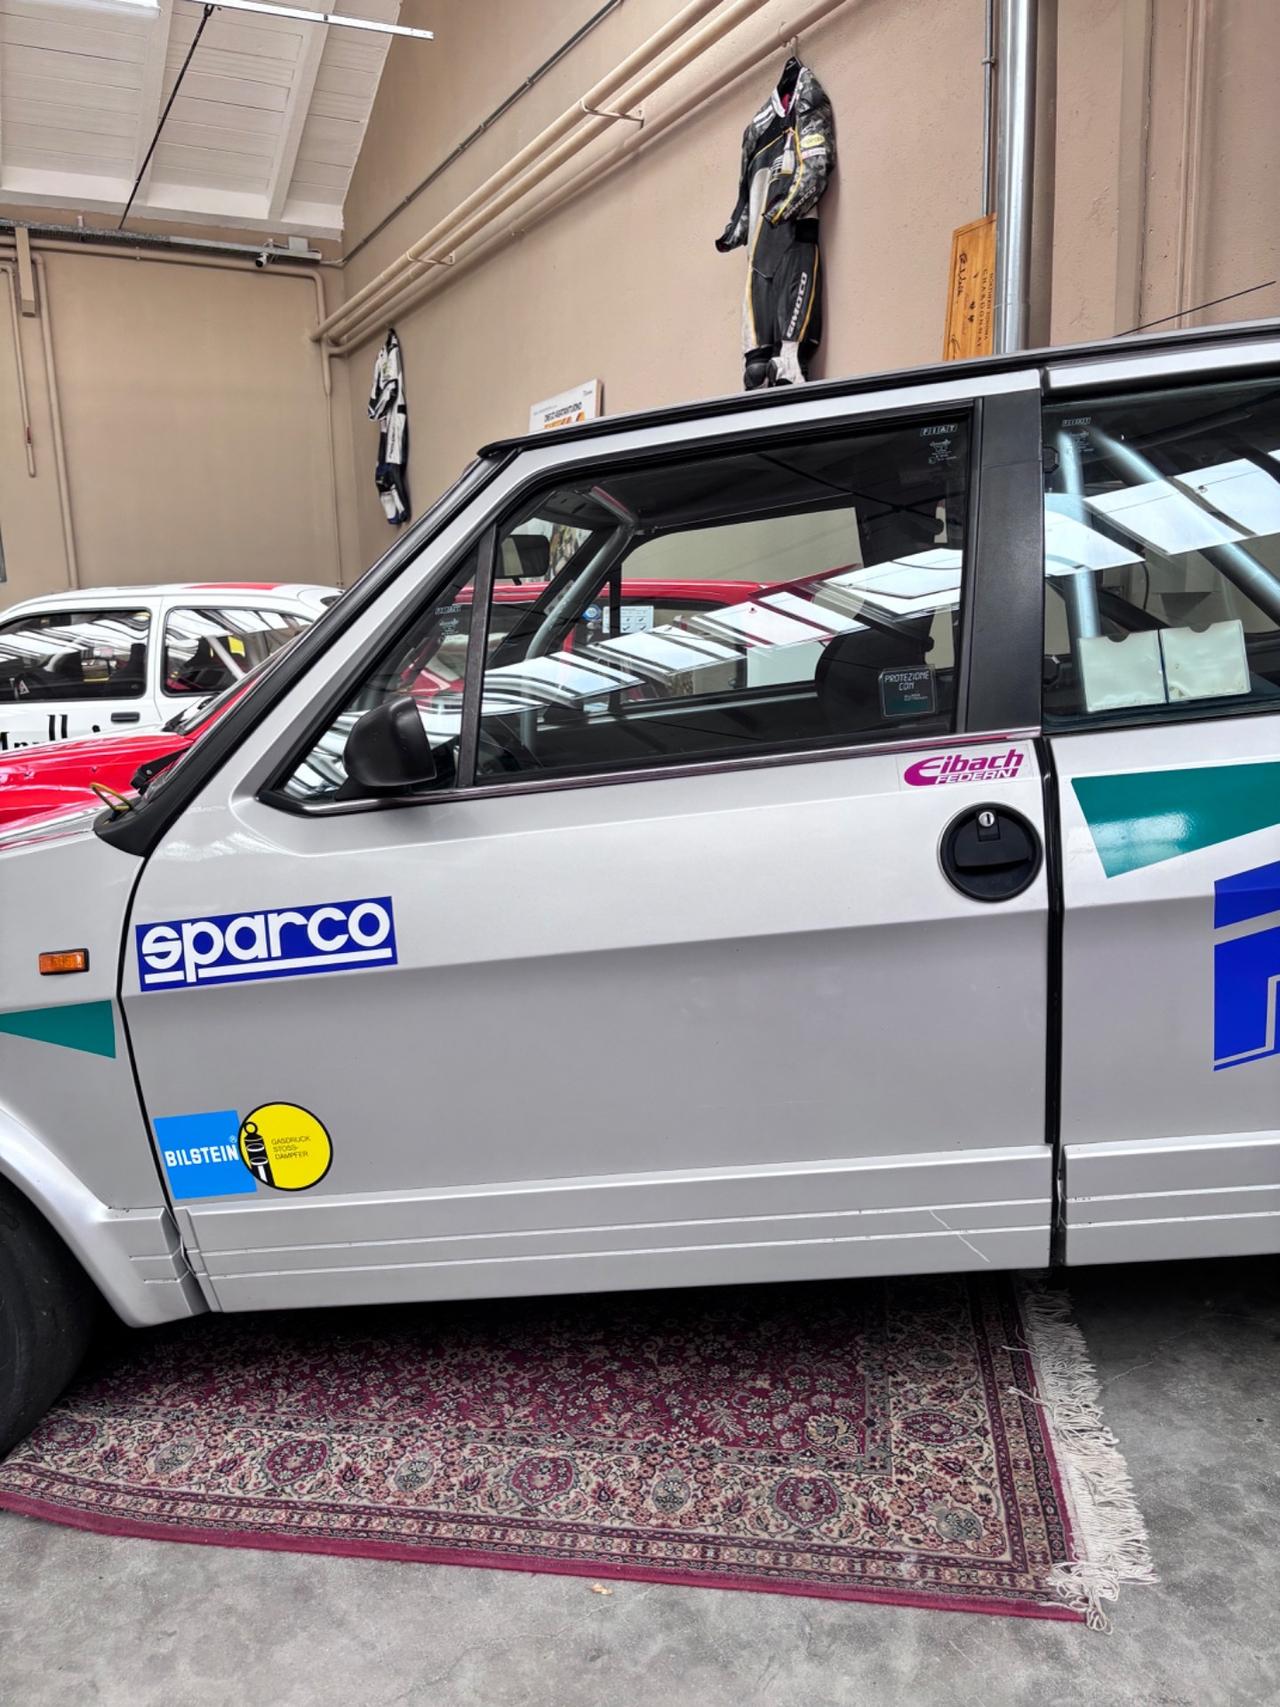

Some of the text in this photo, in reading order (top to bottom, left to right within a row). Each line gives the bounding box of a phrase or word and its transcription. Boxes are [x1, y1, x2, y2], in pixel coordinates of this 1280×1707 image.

[884, 670, 929, 682] PROTEZIONE
[904, 749, 1024, 786] Eibach
[935, 768, 1013, 785] FEDERN
[142, 902, 390, 983] sparco
[165, 1145, 239, 1167] BILSTEIN
